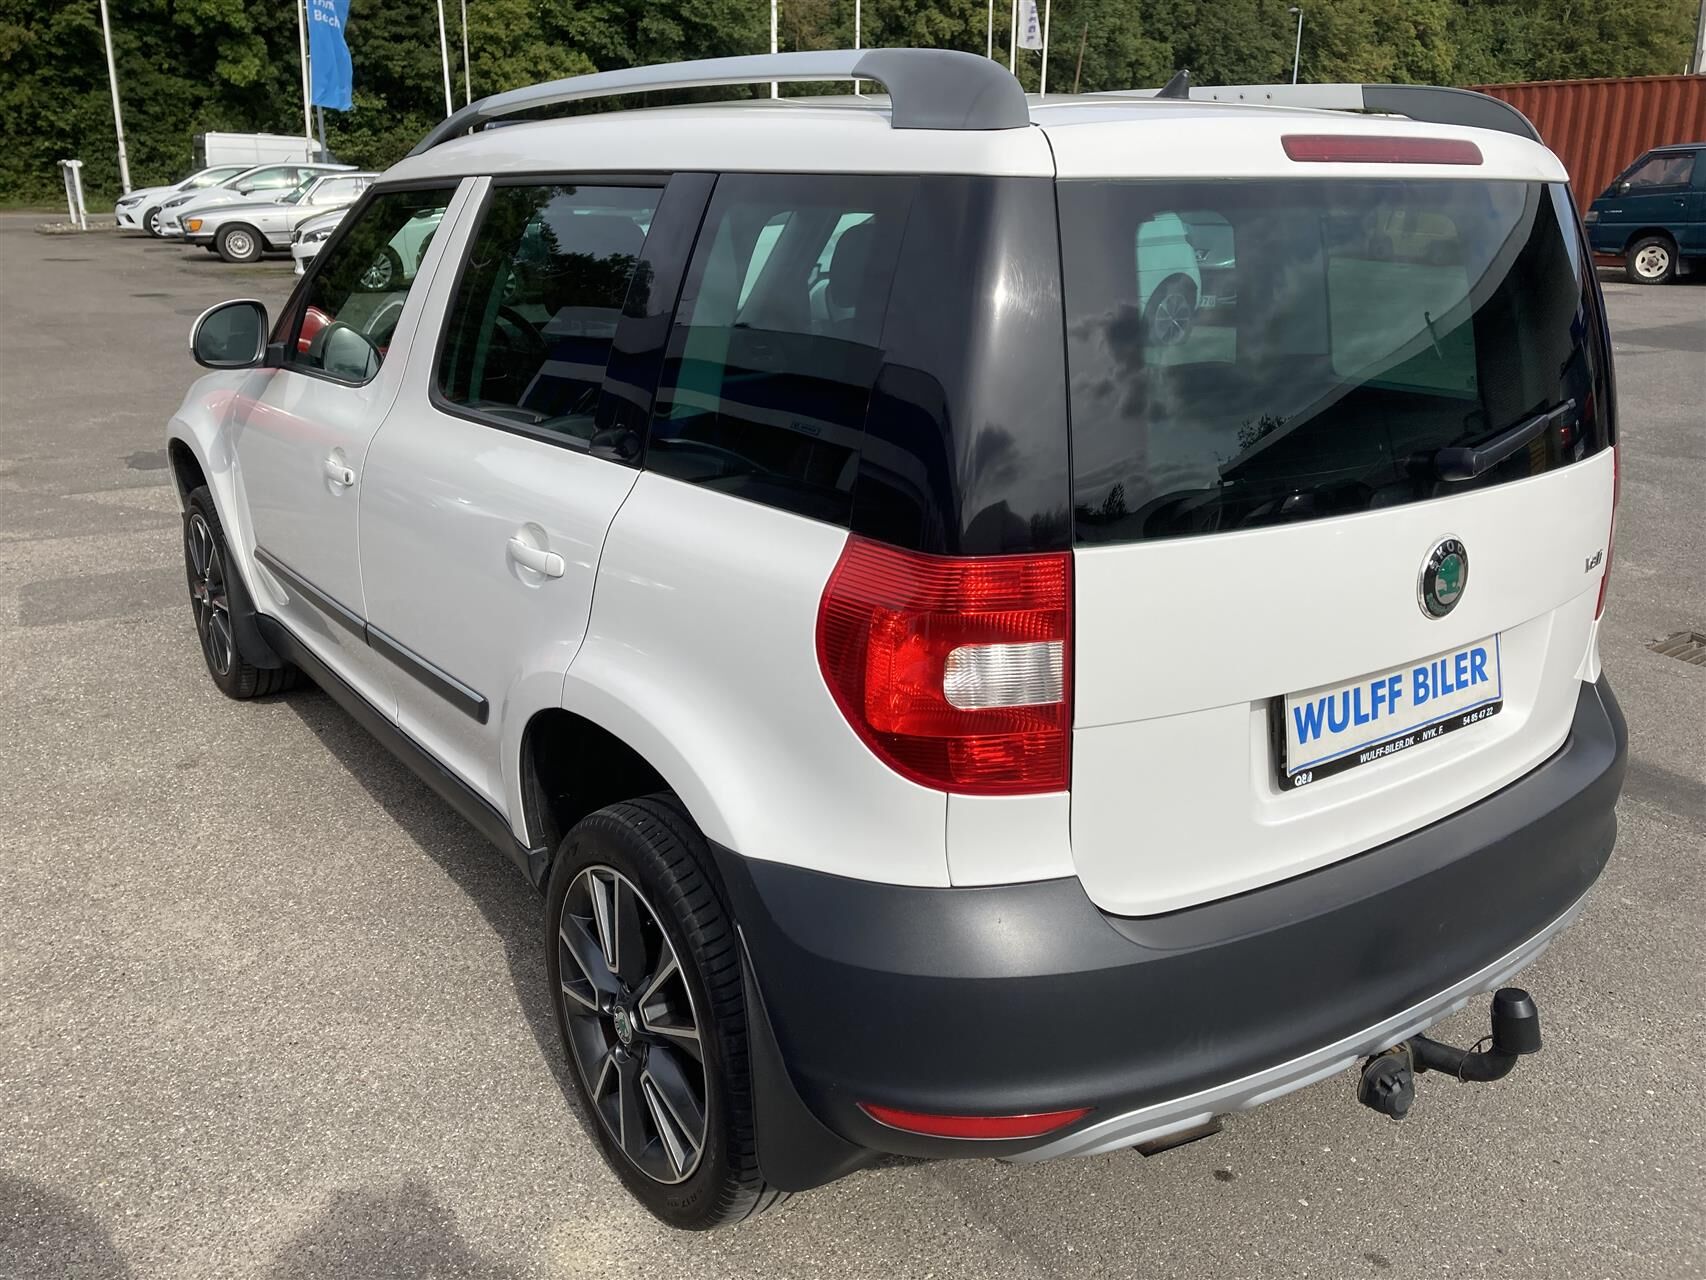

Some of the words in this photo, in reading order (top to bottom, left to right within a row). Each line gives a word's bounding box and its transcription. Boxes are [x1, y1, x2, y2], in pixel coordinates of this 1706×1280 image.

[1293, 674, 1403, 745] WULFF
[1413, 647, 1489, 706] BILER
[1360, 736, 1415, 763] WULFF-BILER.DK
